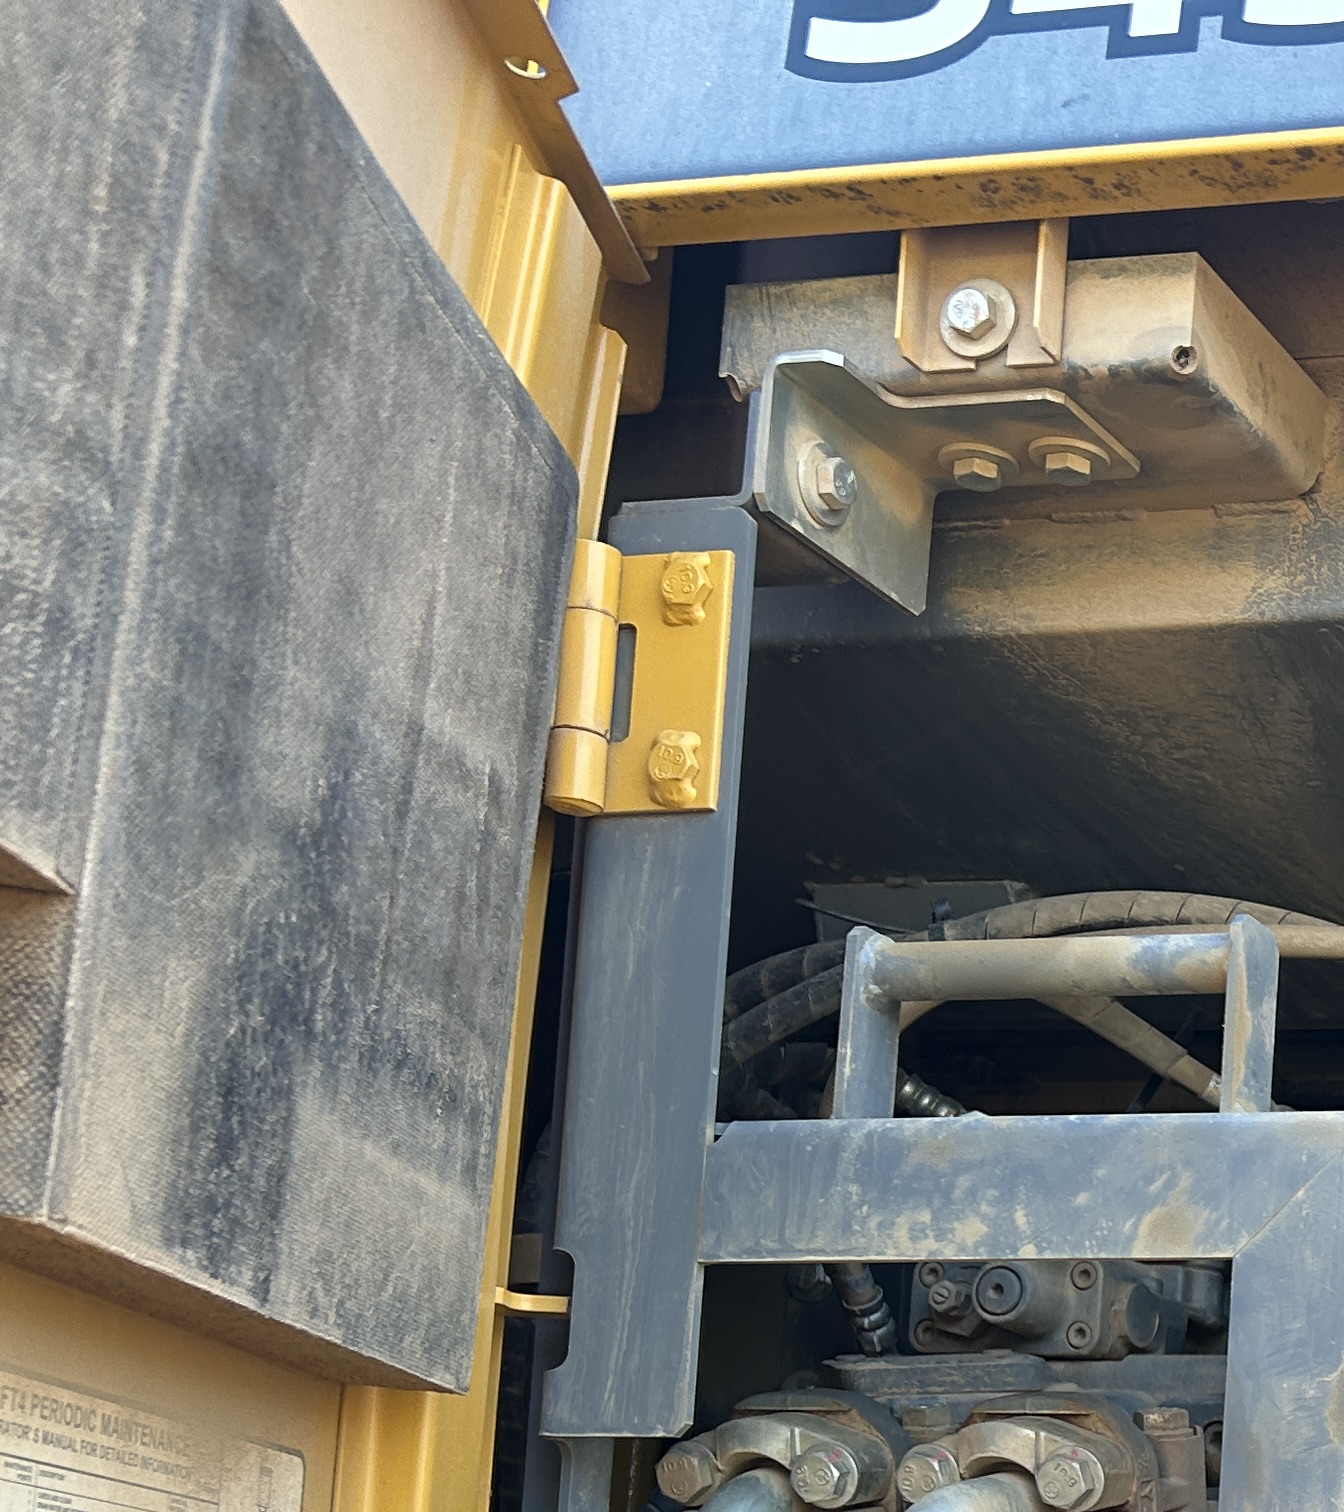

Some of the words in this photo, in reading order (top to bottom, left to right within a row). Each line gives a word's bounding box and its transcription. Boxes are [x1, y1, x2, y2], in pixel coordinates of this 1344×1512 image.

[30, 1392, 97, 1433] PERIODIC
[100, 1412, 192, 1458] MAINTENANCE
[42, 1430, 77, 1453] MANUAL
[80, 1439, 97, 1457] FOR
[99, 1445, 138, 1466] DETAILED
